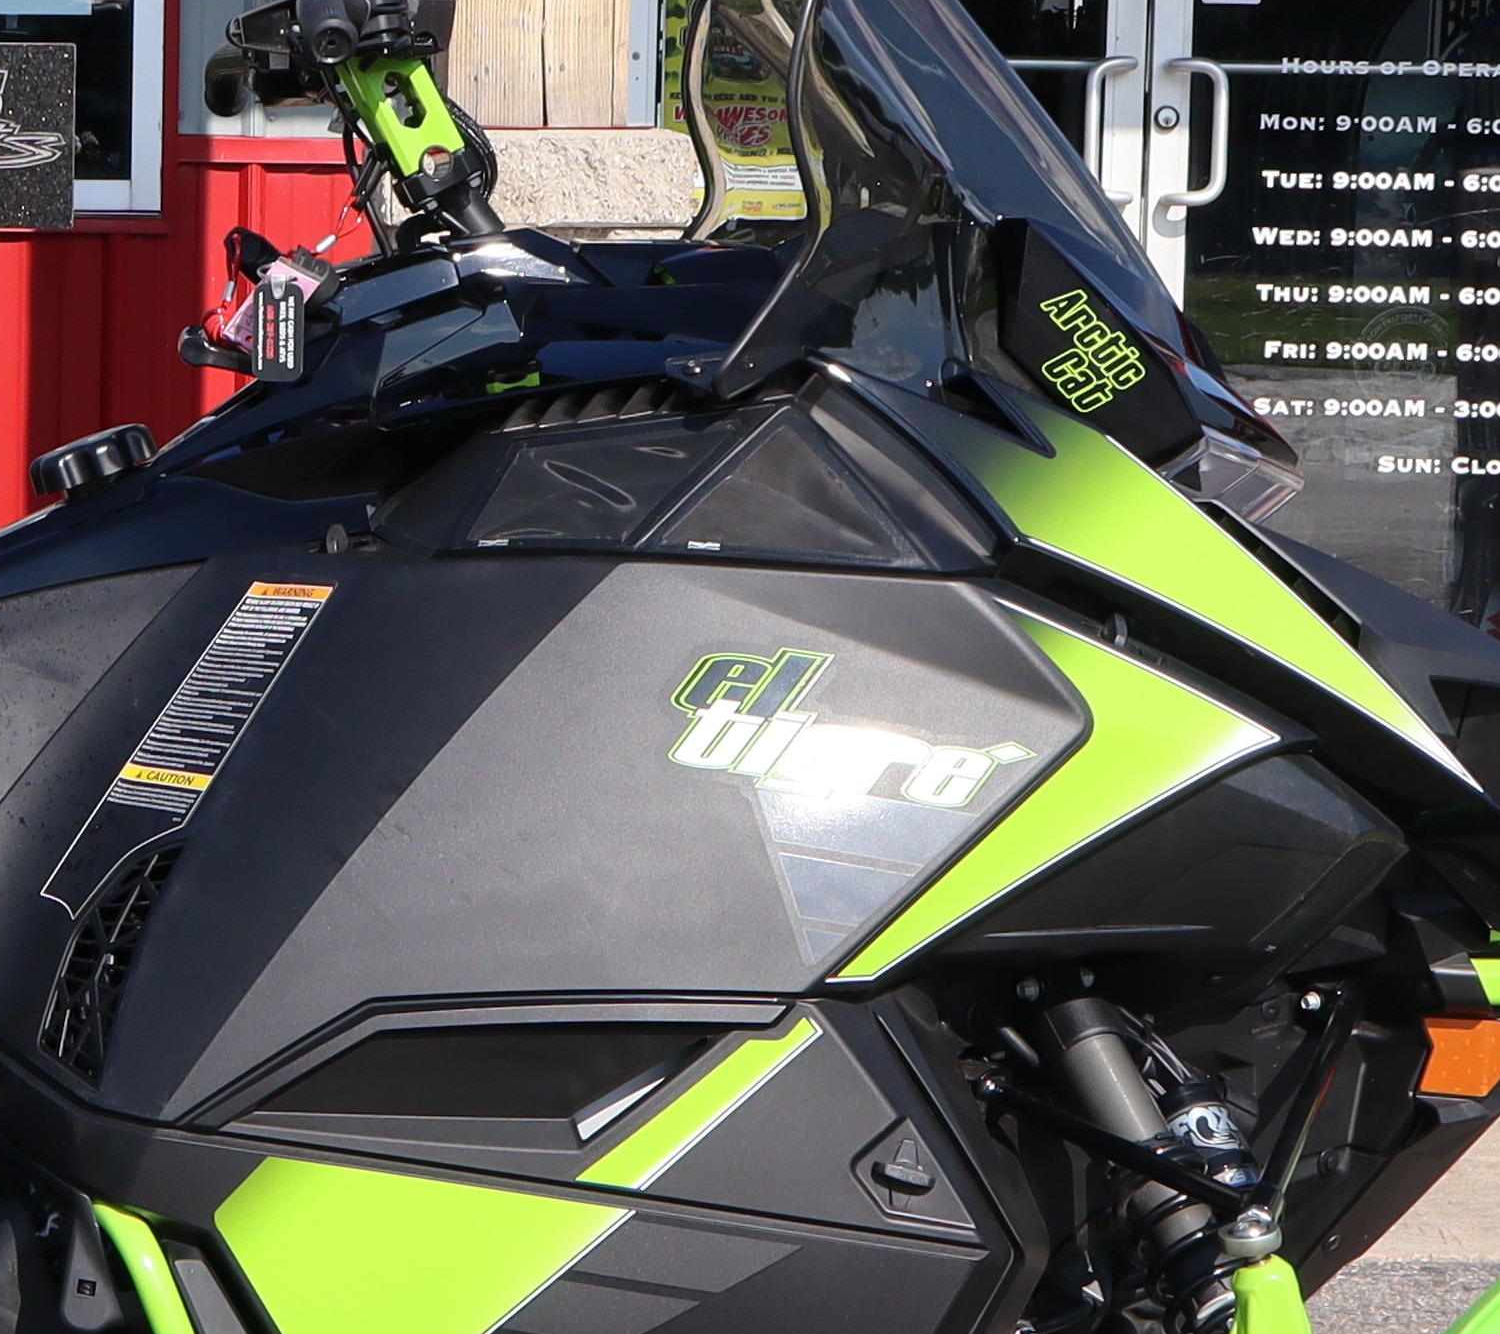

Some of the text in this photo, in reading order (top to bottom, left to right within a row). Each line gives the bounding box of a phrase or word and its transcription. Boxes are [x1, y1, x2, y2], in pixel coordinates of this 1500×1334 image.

[1281, 57, 1370, 76] HOURS
[1380, 60, 1413, 76] OF
[1259, 113, 1326, 132] MON:
[1335, 115, 1438, 134] 9:00AM
[1261, 170, 1323, 189] TUE:
[1332, 172, 1435, 191] 9:00AM
[1252, 227, 1321, 246] WED:
[1330, 229, 1433, 248] 9:00AM
[1256, 284, 1319, 303] THU:
[1327, 285, 1430, 305] 9:00AM
[1040, 289, 1146, 390] Arctic
[1263, 341, 1316, 360] FRI:
[1325, 342, 1428, 362] 9:00AM
[1041, 348, 1114, 413] Cat
[1252, 398, 1314, 417] SAT:
[1324, 399, 1426, 418] 9:00AM
[1377, 455, 1441, 475] SUN:
[272, 586, 316, 598] WARNING
[670, 646, 836, 718] el
[145, 770, 196, 786] CAUTION
